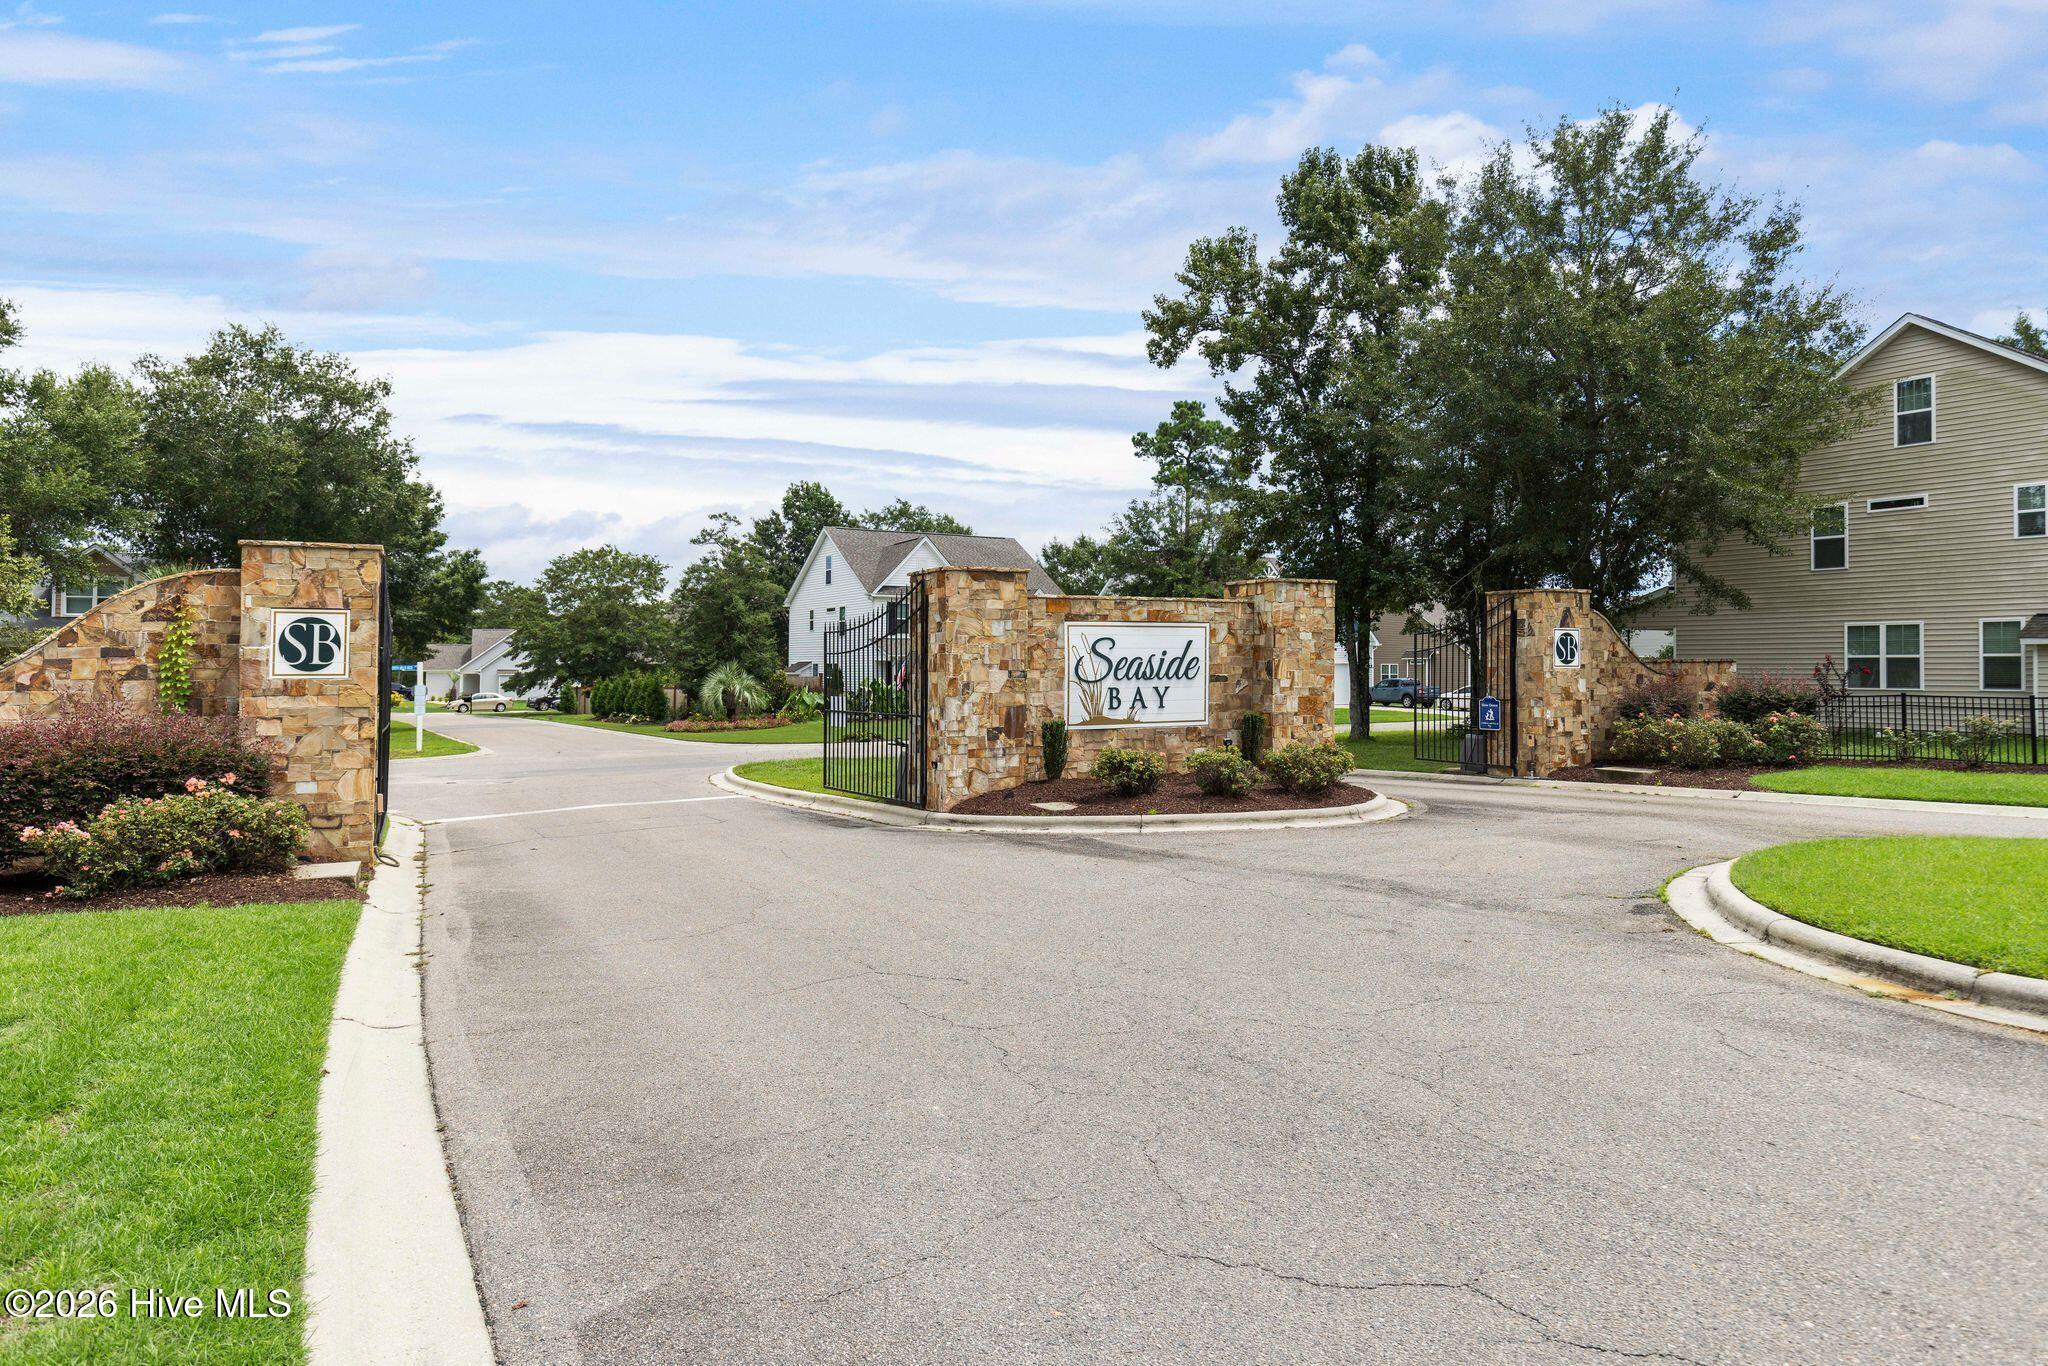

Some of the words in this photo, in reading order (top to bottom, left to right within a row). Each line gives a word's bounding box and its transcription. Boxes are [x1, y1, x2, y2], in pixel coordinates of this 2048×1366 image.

[282, 622, 340, 665] SB
[1074, 636, 1201, 683] Seaside
[1557, 635, 1577, 661] SB
[1107, 686, 1170, 711] BAY
